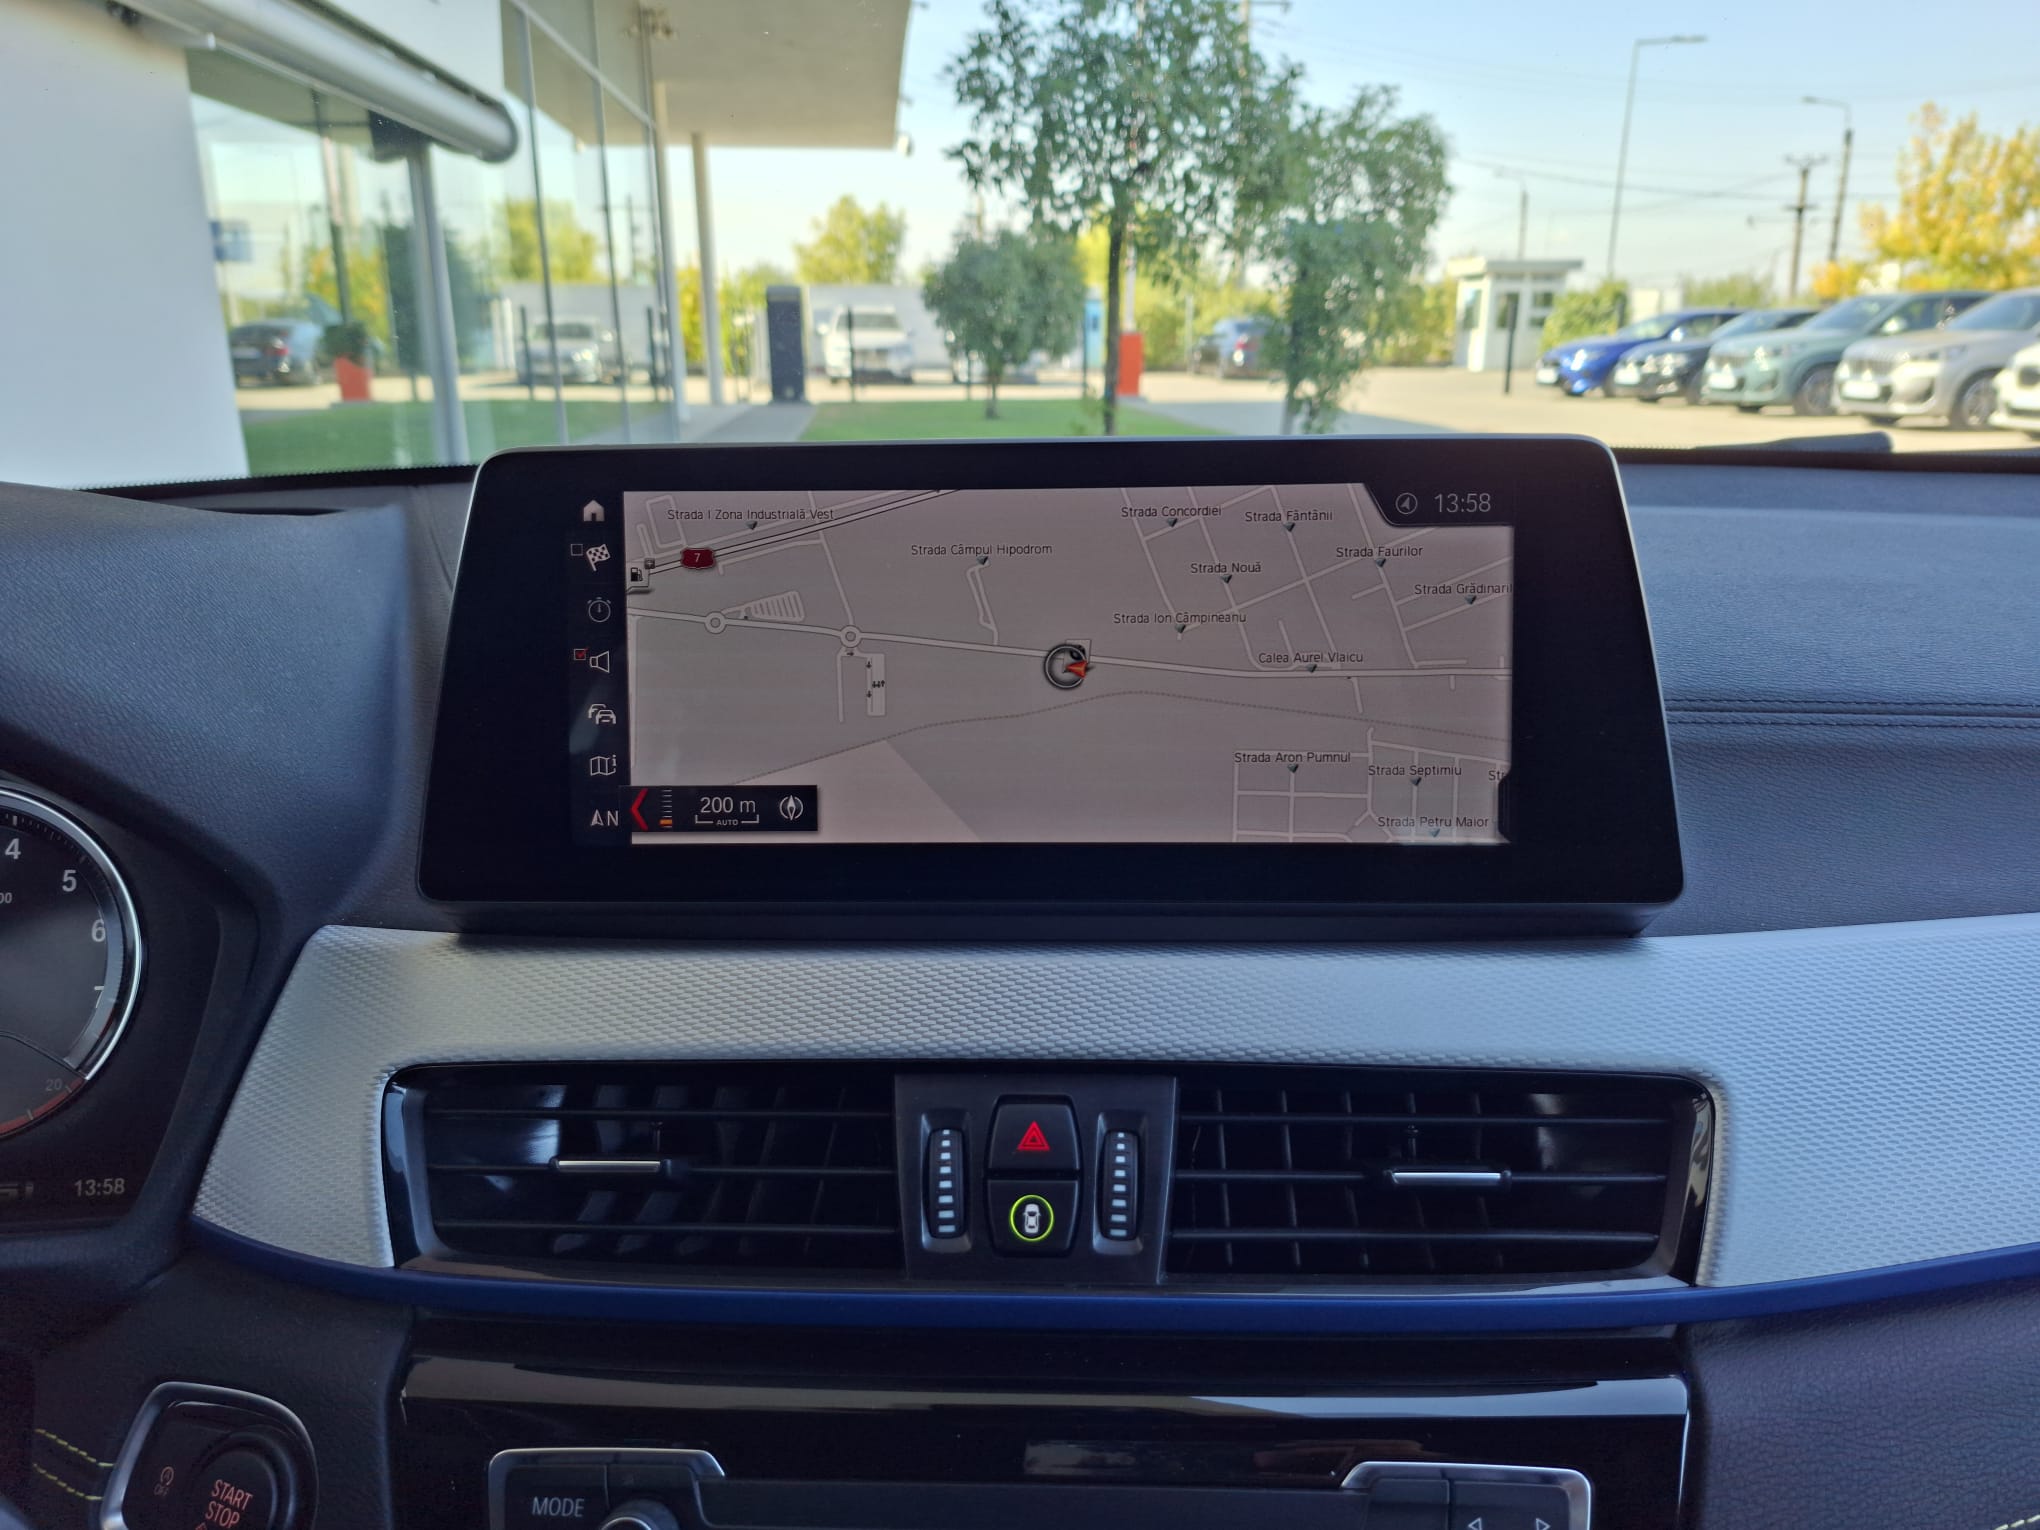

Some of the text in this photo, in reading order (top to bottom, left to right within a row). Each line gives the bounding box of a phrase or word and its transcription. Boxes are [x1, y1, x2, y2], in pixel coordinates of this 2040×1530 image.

[1434, 492, 1491, 513] 13:58
[667, 509, 704, 520] Strada
[715, 509, 743, 520] Zona
[747, 508, 806, 520] Industrială
[809, 509, 834, 520] Vest
[1121, 506, 1158, 517] Strada
[1245, 509, 1333, 522] Strada Fântânii
[911, 543, 1053, 557] Strada Câmpul Hipodrom
[1336, 546, 1424, 558] Strada Faurilor
[693, 552, 702, 564] 7
[1191, 562, 1262, 574] Strada Nouă
[1414, 584, 1452, 595] Strada
[1113, 611, 1247, 625] Strada Ion Câmpineanu
[1258, 652, 1364, 664] Calea Aurel Vlaicu
[1234, 752, 1351, 763] Strada Aron Pumnul
[1368, 765, 1462, 777] Strada Septimiu
[700, 797, 756, 814] 200 m
[716, 818, 739, 826] AUTO
[1378, 816, 1488, 827] Strada Petru Maior
[4, 838, 22, 860] 4
[61, 869, 78, 892] 5
[91, 918, 106, 942] 6
[45, 1078, 63, 1092] 20
[74, 1178, 126, 1197] 13:58
[211, 1479, 254, 1511] START
[531, 1496, 585, 1518] MODE
[205, 1500, 241, 1529] STOP
